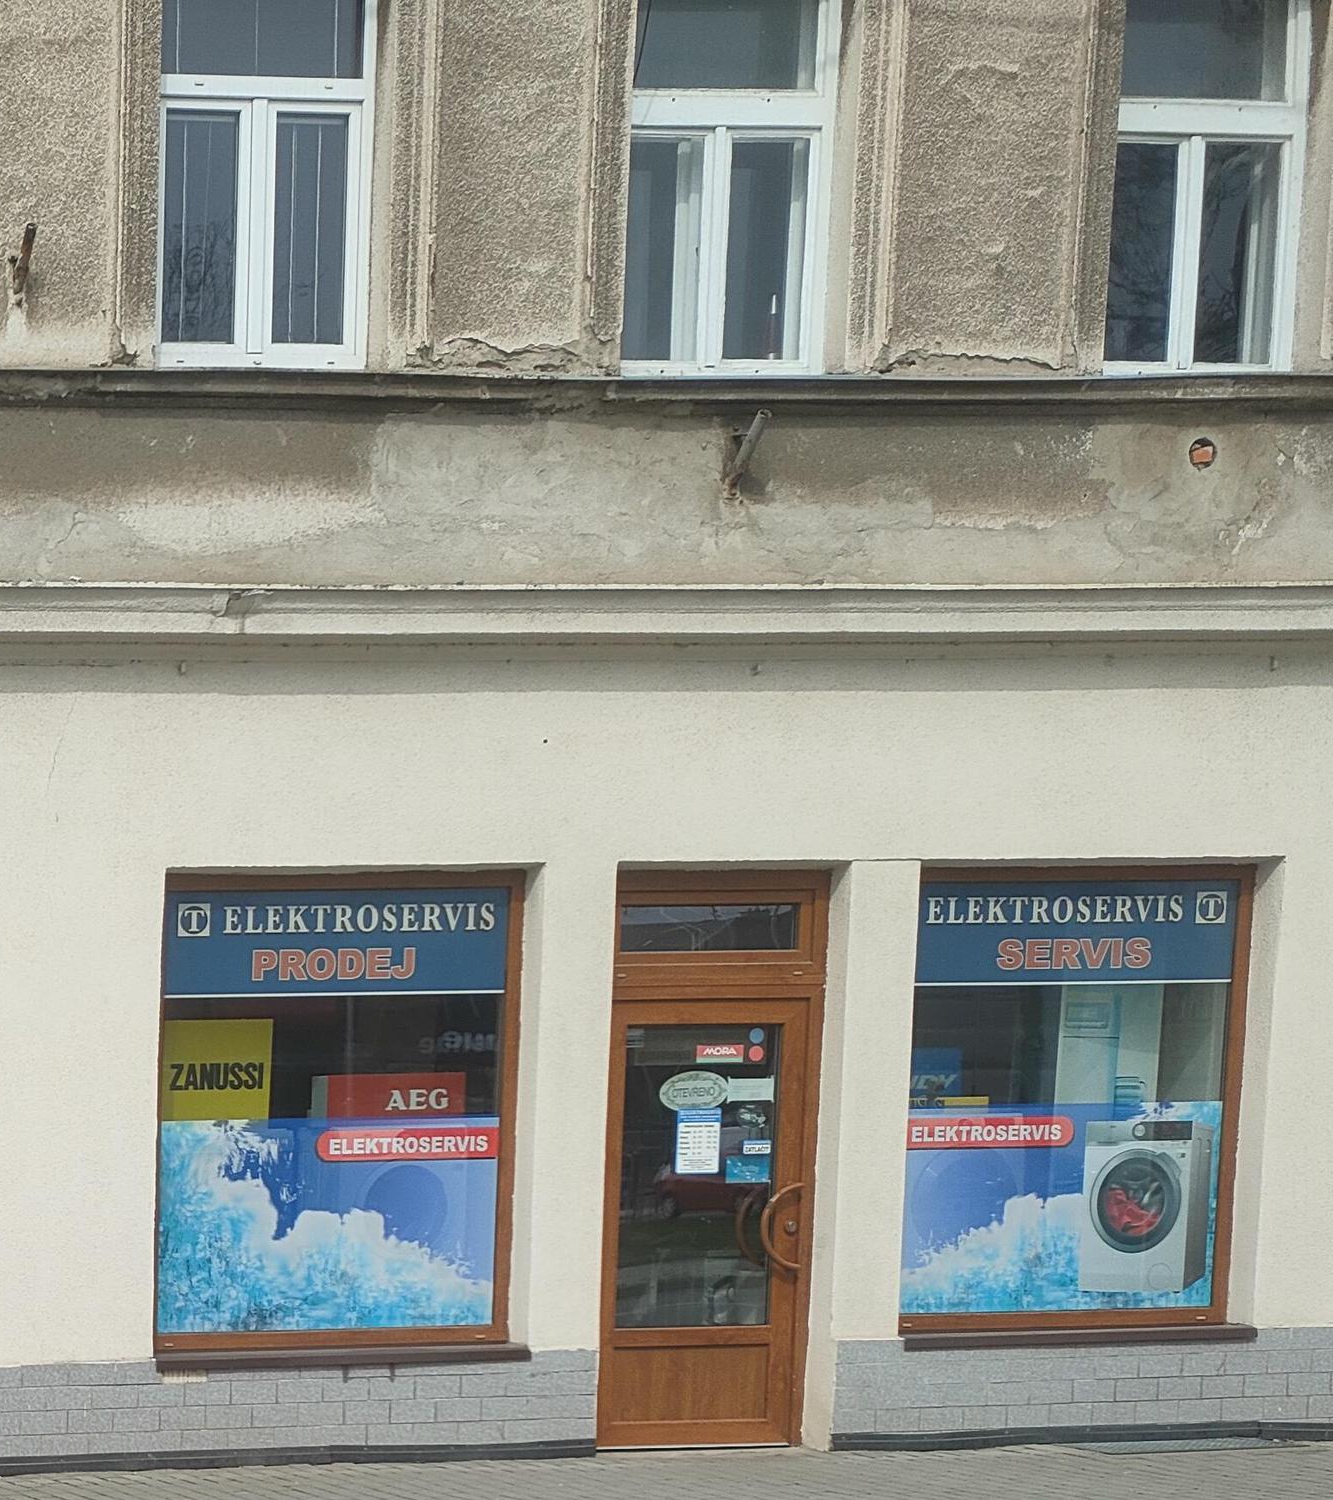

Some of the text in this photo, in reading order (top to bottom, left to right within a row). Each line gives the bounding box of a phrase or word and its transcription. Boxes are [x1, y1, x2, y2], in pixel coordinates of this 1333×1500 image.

[223, 903, 496, 934] ELEKTROSERVIS
[926, 894, 1184, 924] ELEKTROSERVIS
[251, 947, 416, 981] PRODEJ
[996, 937, 1152, 970] SERVIS
[702, 1046, 737, 1056] MORA
[169, 1063, 264, 1090] ZANUSSI
[385, 1088, 450, 1111] AEG
[328, 1135, 489, 1155] ELEKTROSERVIS
[911, 1124, 1062, 1142] ELEKTROSERVIS
